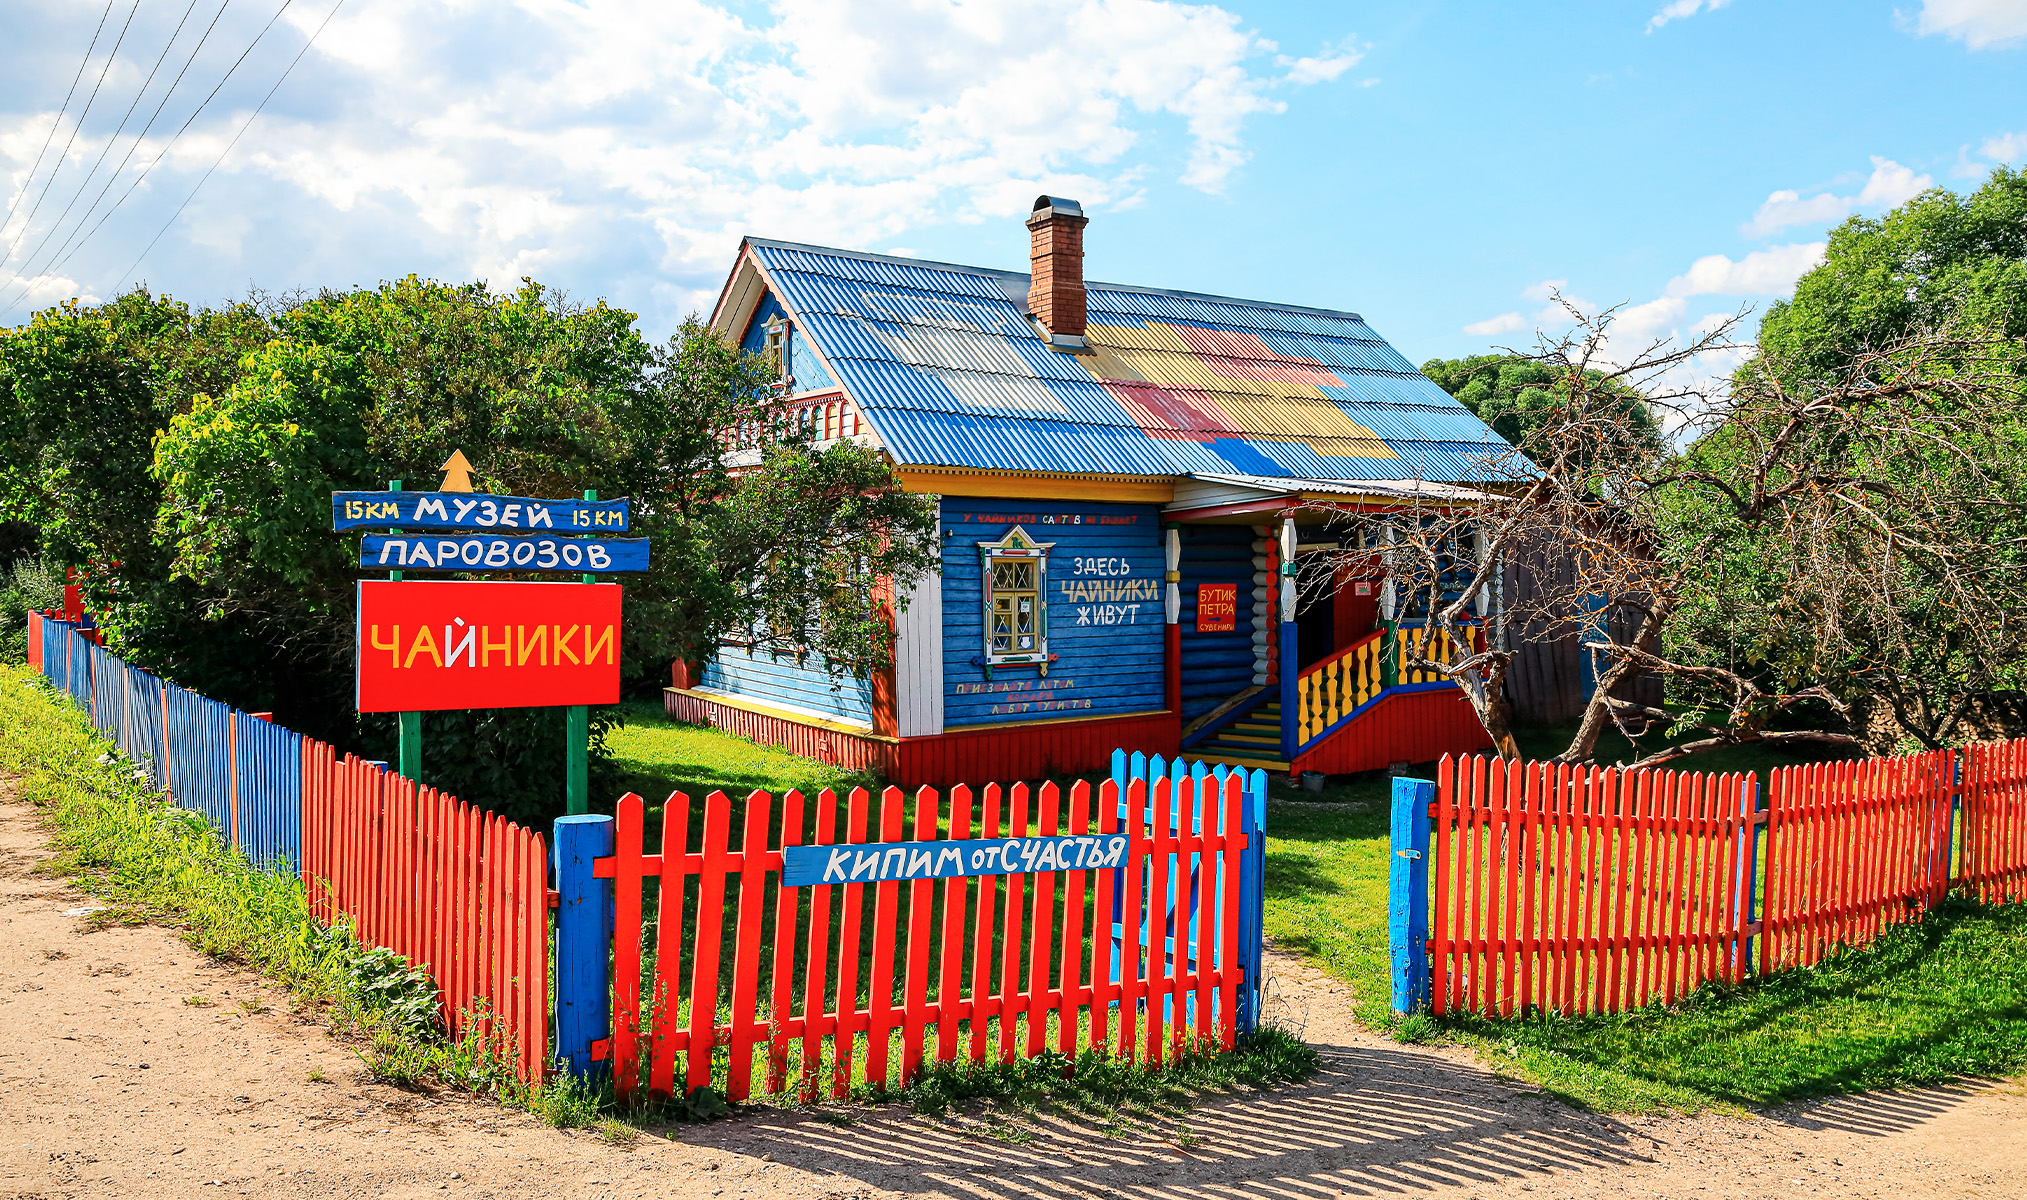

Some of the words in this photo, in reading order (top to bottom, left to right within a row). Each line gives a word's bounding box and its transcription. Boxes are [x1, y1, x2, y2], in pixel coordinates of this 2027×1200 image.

[413, 497, 553, 529] МУЗЕЙ
[572, 509, 591, 526] 15
[963, 514, 972, 523] У
[977, 513, 1037, 524] ЧАЙНИКОВ
[1042, 514, 1081, 524] САЙТОВ
[1085, 515, 1097, 524] НЕ
[1100, 515, 1138, 525] БЫВАЕТ
[378, 540, 612, 569] ПАРОВОЗОВ
[1073, 557, 1130, 576] ЗДЕСЬ
[1061, 579, 1159, 603] ЧАЙНИКИ
[1200, 589, 1236, 602] БУТИК
[1076, 604, 1141, 626] ЖИВУТ
[1199, 603, 1235, 615] ПЕТРА
[371, 616, 614, 669] ЧАЙНИКИ
[956, 682, 1032, 694] ПРИЕЗЖАЙТЕ
[1039, 679, 1074, 690] ЛЕТОМ
[1006, 691, 1053, 702] КОМАРЫ
[992, 703, 1030, 714] ЛЮБЯТ
[1036, 699, 1091, 711] ТУРИСТОВ
[822, 847, 965, 882] КИПИМ
[1000, 836, 1126, 873] СЧАСТЬЯ
